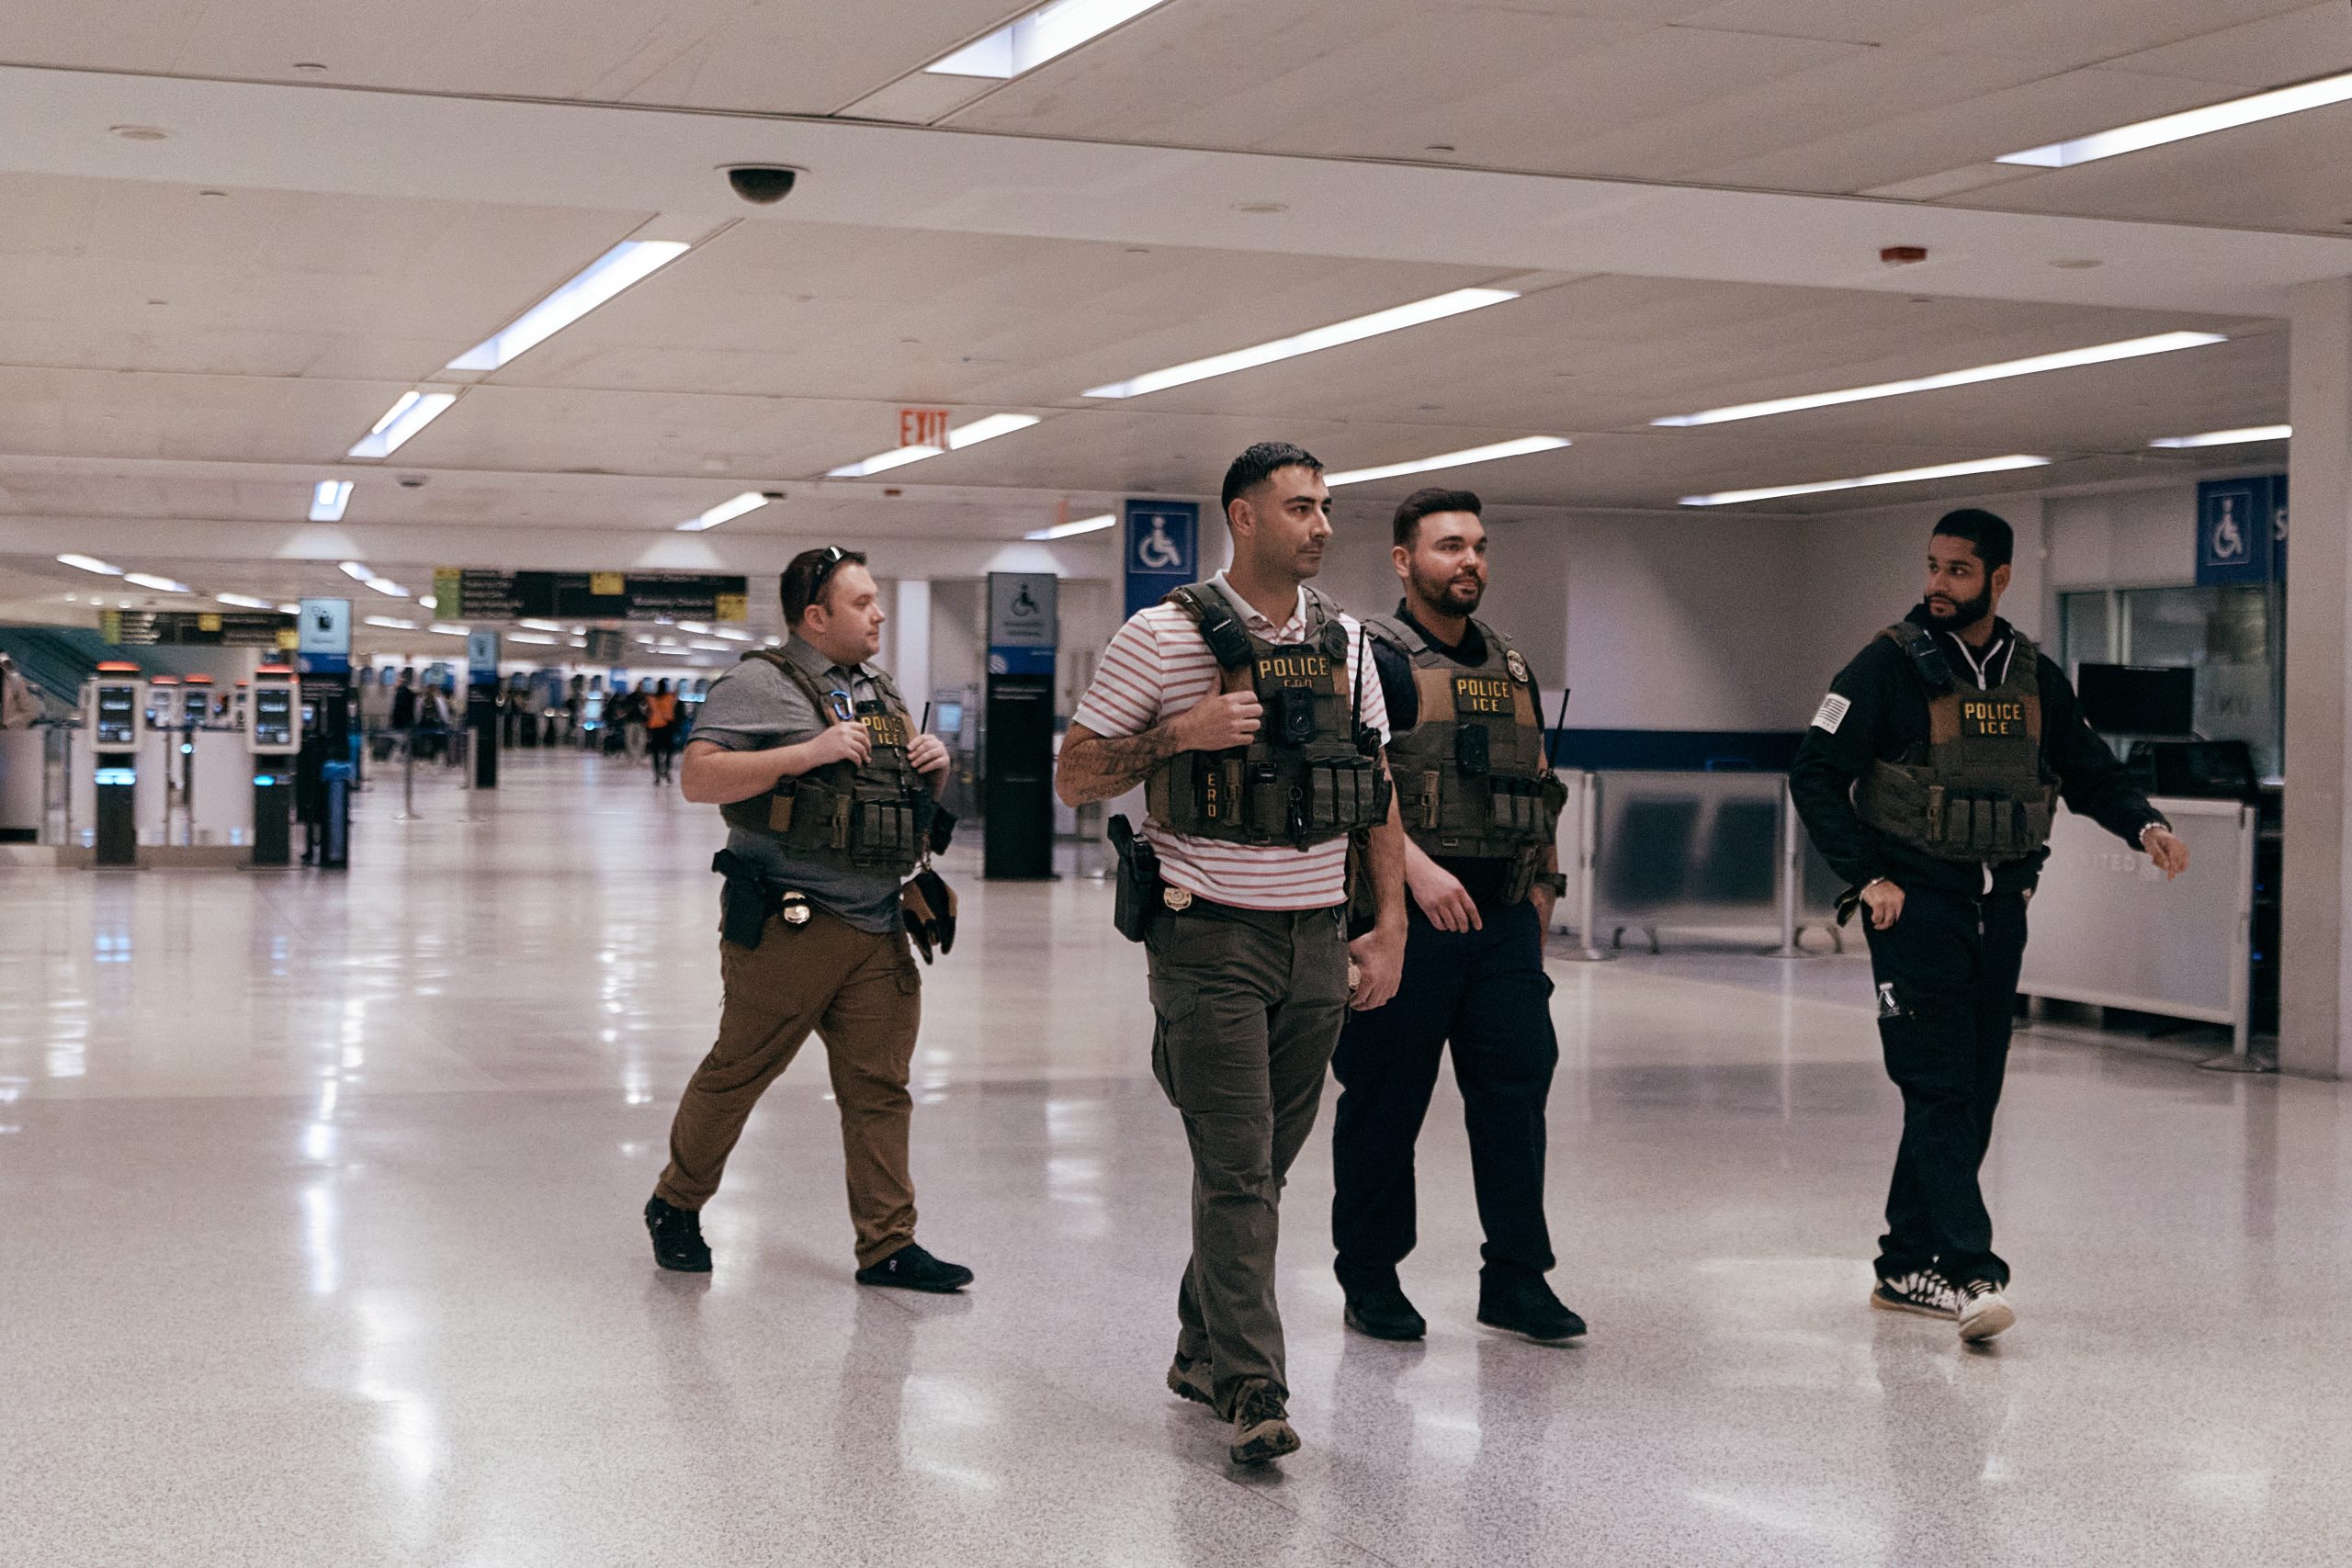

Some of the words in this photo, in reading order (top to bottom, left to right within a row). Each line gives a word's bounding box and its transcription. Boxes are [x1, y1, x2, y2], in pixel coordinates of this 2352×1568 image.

[900, 410, 949, 449] EXIT
[1259, 657, 1329, 679] POLICE
[1457, 679, 1510, 698] POLICE
[1473, 699, 1499, 712] ICE
[1964, 702, 2021, 720] POLICE
[1979, 721, 2009, 735] ICE
[1207, 773, 1216, 818] ERO
